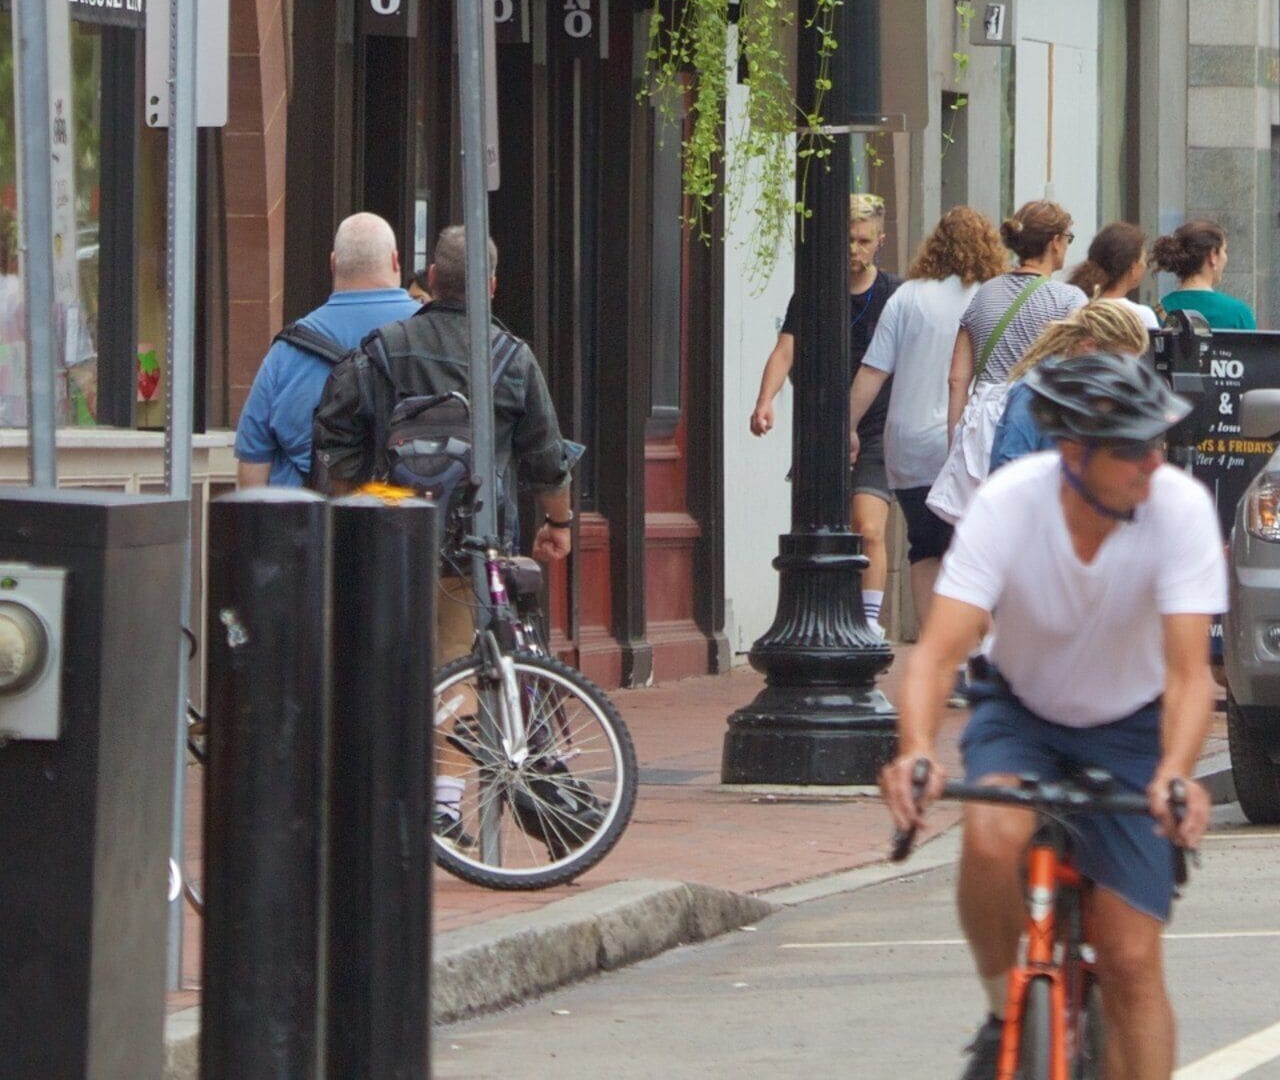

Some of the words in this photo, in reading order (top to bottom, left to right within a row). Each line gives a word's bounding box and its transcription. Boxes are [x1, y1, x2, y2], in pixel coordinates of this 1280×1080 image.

[1210, 359, 1245, 379] NO
[1218, 392, 1233, 415] &
[1217, 440, 1225, 452] &
[1228, 440, 1275, 454] FRIDAYS
[1196, 453, 1214, 466] fter
[1217, 454, 1226, 466] 4
[1227, 456, 1245, 470] pm
